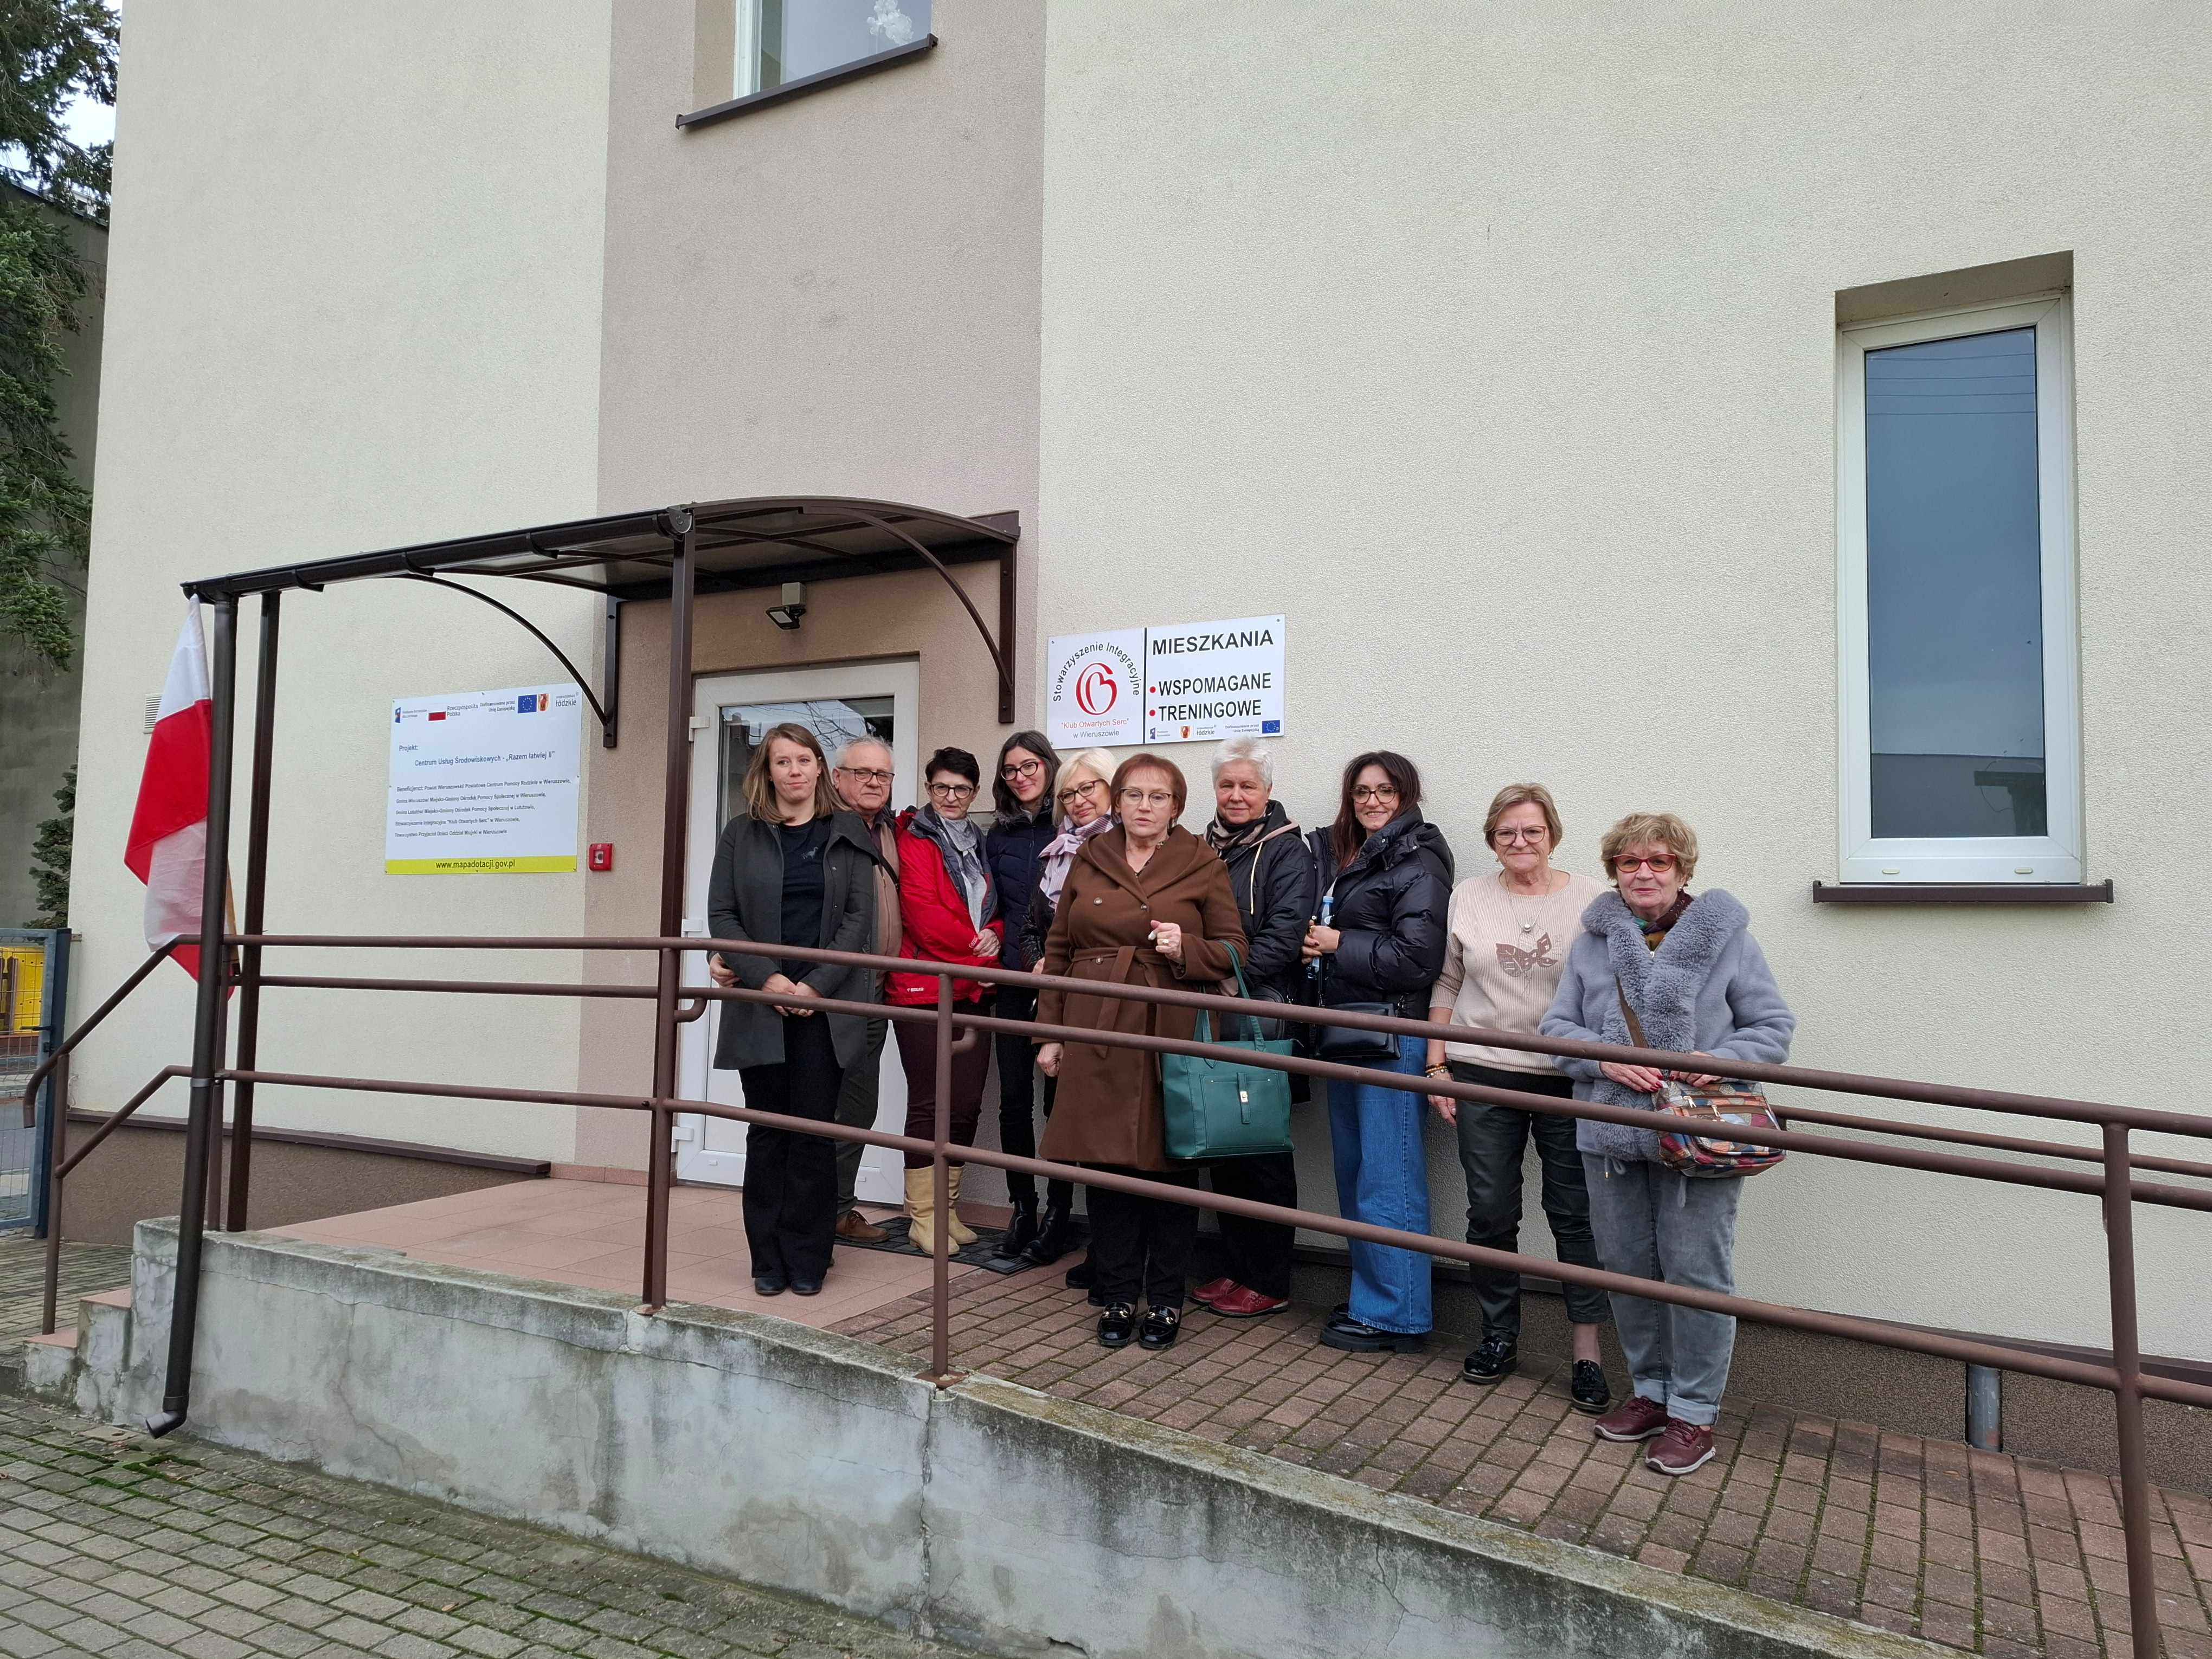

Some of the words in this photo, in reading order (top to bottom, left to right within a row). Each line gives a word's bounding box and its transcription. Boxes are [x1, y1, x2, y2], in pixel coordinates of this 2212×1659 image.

[1153, 629, 1274, 655] MIESZKANIA
[1053, 642, 1103, 702] Stowarzyszenie
[1107, 642, 1141, 696] Integracyjne
[1159, 672, 1271, 696] WSPOMAGANE
[1158, 699, 1262, 721] TRENINGOWE
[1079, 719, 1110, 729] Otwartych
[1081, 730, 1120, 738] Wieruszowie
[455, 754, 501, 764] Środowiskowych
[436, 859, 515, 869] www.mapadotacji.gov.pl
